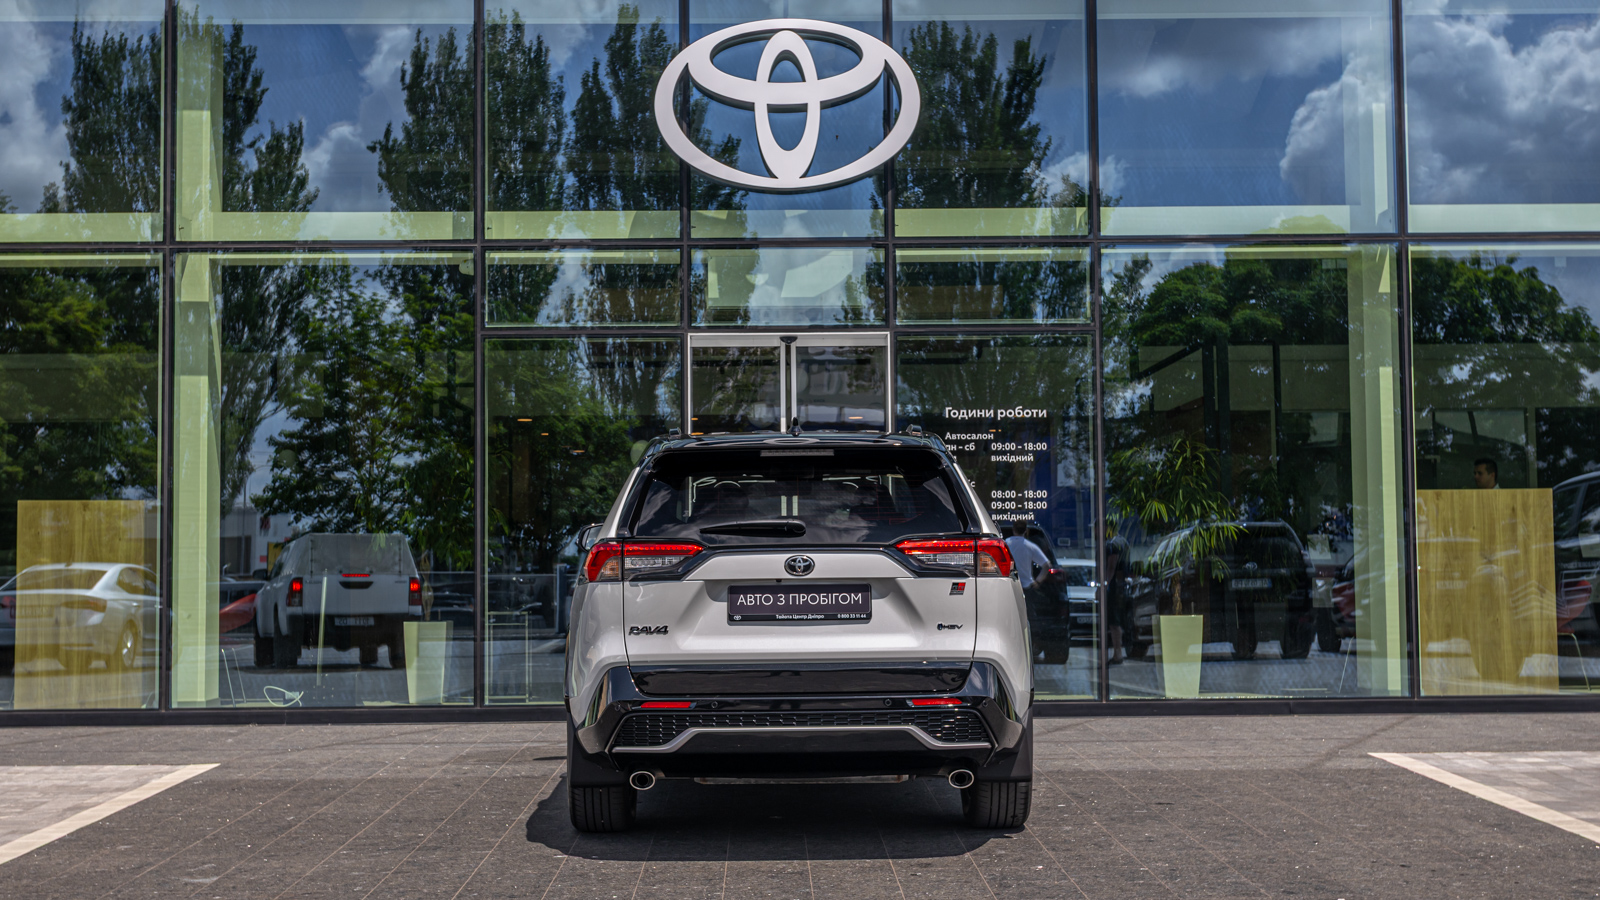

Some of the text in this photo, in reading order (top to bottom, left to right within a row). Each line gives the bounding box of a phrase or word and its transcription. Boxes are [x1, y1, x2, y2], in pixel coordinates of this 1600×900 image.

[945, 406, 1047, 420] Години роботи
[945, 432, 994, 440] Автосалон
[964, 442, 976, 451] сб
[991, 442, 1016, 451] 09:00
[1023, 442, 1048, 451] 18:00
[991, 453, 1034, 463] вихідний
[991, 490, 1016, 499] 08:00
[1023, 490, 1048, 499] 18:00
[991, 501, 1016, 510] 09:00
[1023, 501, 1048, 510] 18:00
[991, 512, 1034, 521] вихідний
[736, 593, 774, 606] АВТО
[789, 592, 862, 606] ПРОБІГОМ
[628, 625, 669, 636] RAV4
